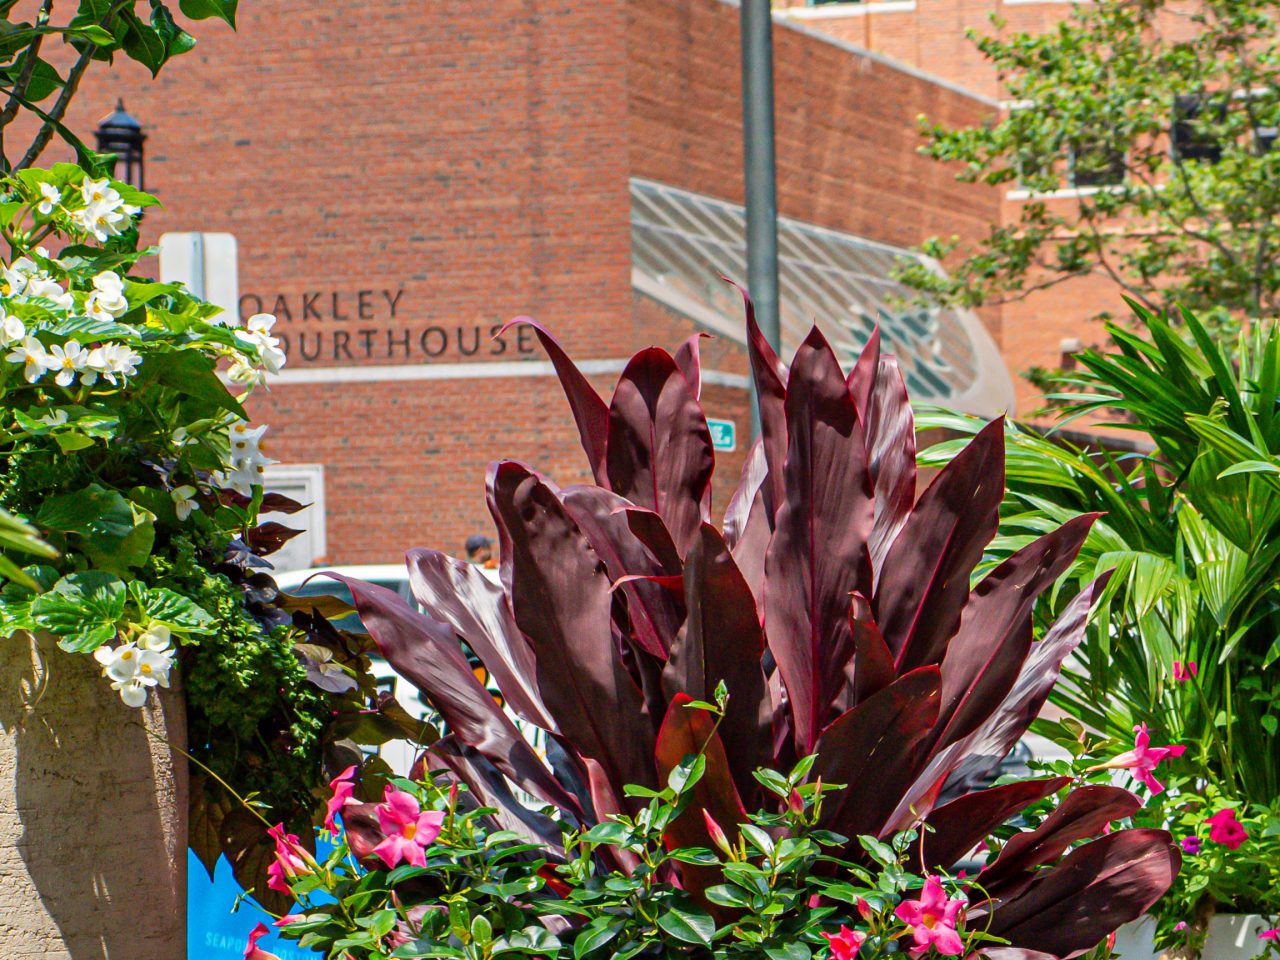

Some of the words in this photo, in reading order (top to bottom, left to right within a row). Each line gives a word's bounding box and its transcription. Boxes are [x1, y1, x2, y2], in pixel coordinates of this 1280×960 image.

[237, 289, 404, 322] OAKLEY
[270, 324, 535, 362] URTHOUSE
[205, 931, 248, 954] SEAPO
